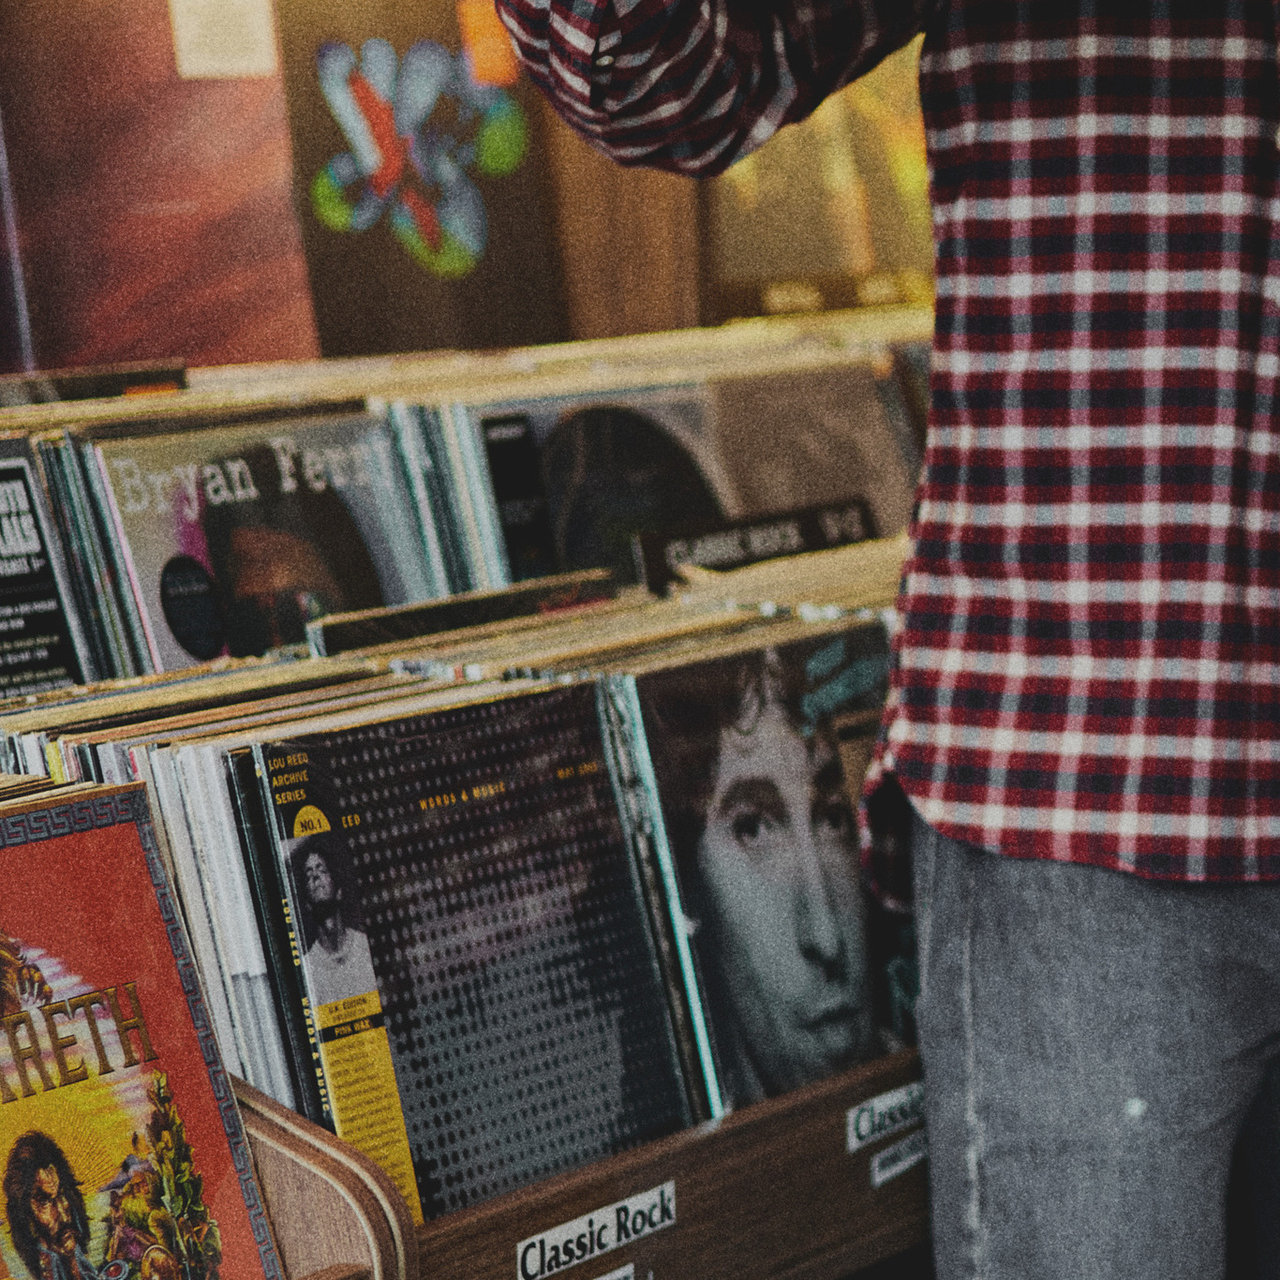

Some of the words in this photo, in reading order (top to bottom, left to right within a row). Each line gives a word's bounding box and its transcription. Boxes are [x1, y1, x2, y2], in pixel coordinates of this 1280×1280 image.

[112, 456, 261, 523] Bryan
[268, 435, 398, 495] Ferry
[268, 756, 285, 771] LOU
[286, 752, 309, 766] REED
[272, 769, 310, 788] ARCHIVE
[275, 788, 307, 805] SERIES
[418, 792, 457, 811] WORDS
[472, 780, 506, 800] MUSIC
[0, 980, 159, 1105] RETH
[615, 1188, 674, 1243] Rock
